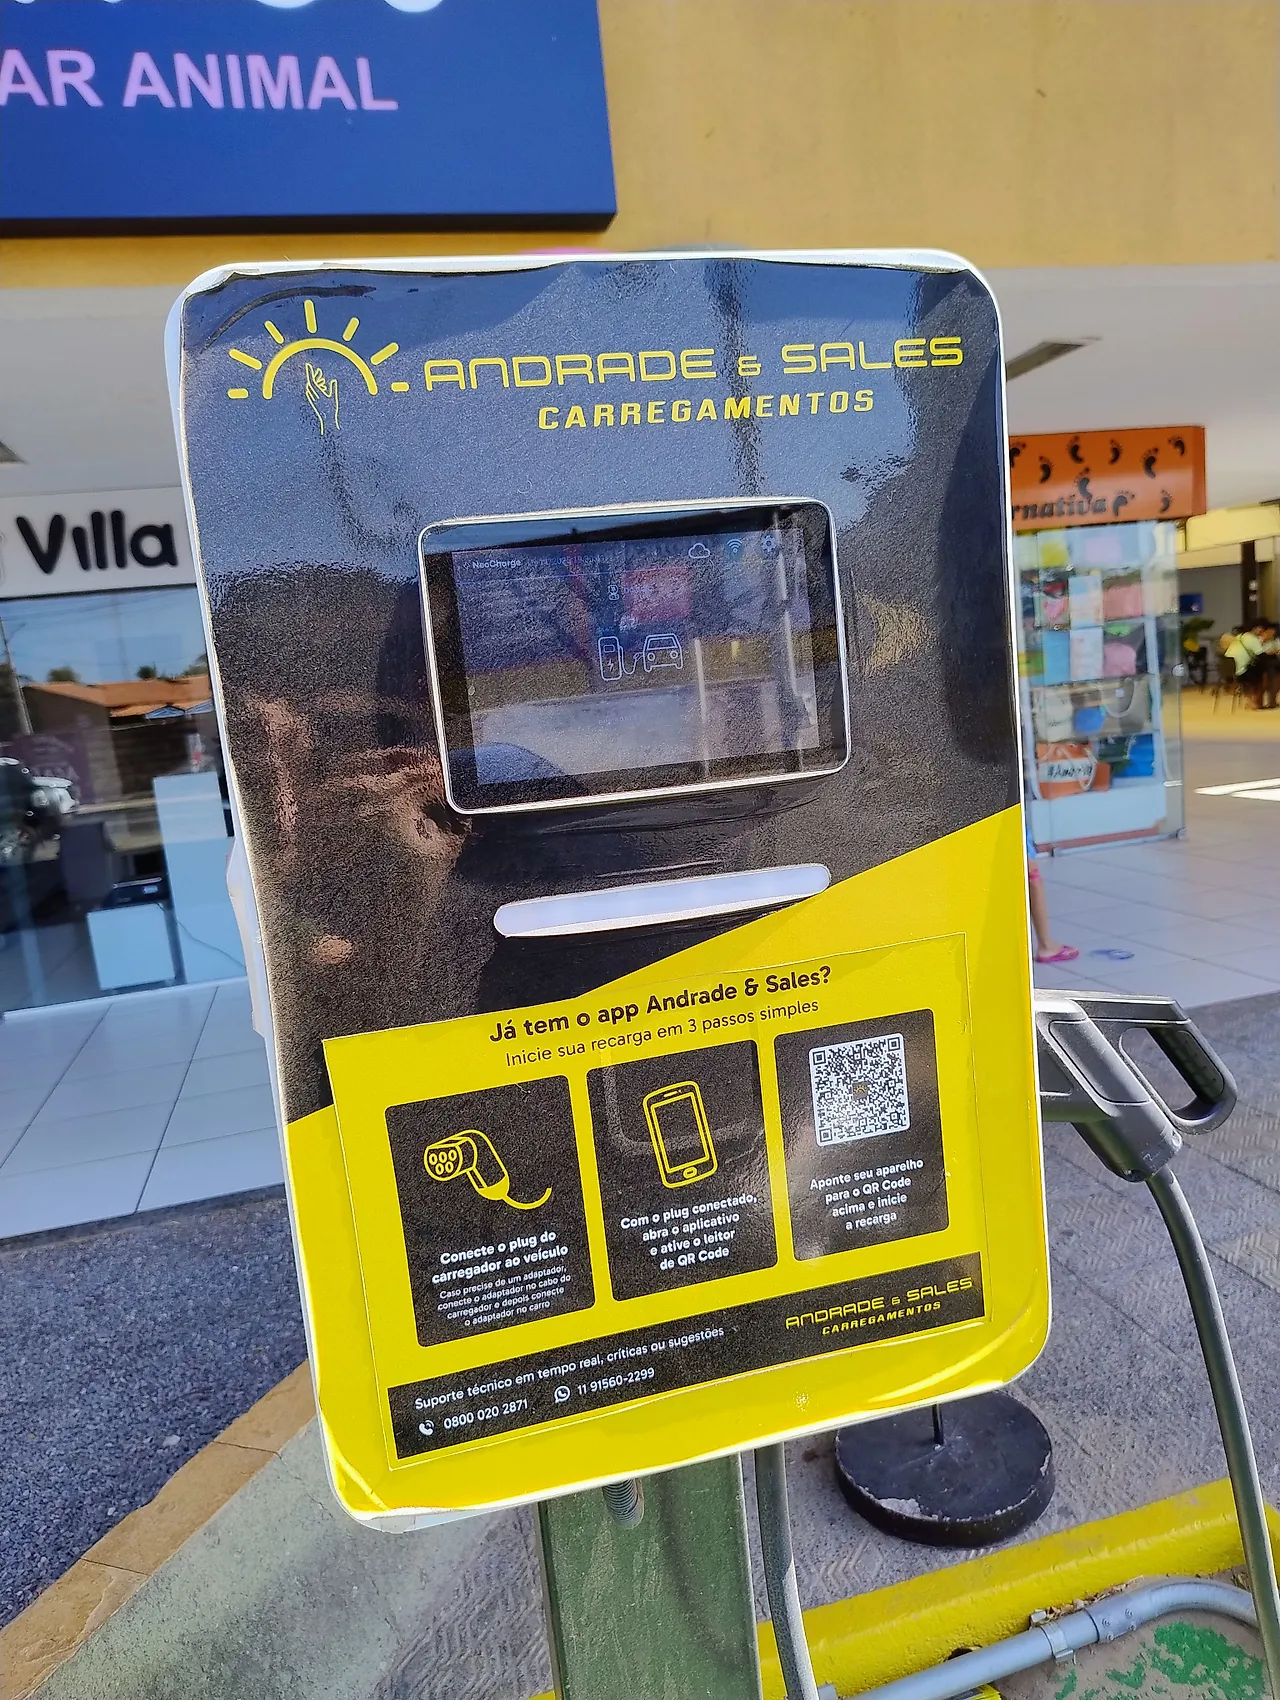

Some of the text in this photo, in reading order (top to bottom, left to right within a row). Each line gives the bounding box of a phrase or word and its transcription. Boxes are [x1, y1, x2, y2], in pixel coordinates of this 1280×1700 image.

[0, 49, 399, 110] AR ANIMAL
[424, 338, 964, 391] ANDRADE & SALES
[538, 390, 875, 430] CARREGAMENTOS
[472, 559, 521, 569] NeoCharge
[490, 966, 832, 1042] Já tem o app Andrade & Sales?
[506, 1000, 819, 1067] Inicie sua recarga em 3 passos simples
[810, 1159, 924, 1190] Aponte seu aparelho
[825, 1177, 911, 1205] para o QR Code
[621, 1194, 757, 1229] Com o plug conectado,
[832, 1193, 907, 1217] acima e inicie
[846, 1212, 897, 1230] a recarga
[642, 1213, 740, 1241] abra o aplicativo
[650, 1229, 735, 1256] e ative o leitor
[440, 1231, 556, 1264] Conecte o plug do
[660, 1247, 729, 1270] de QR Code
[432, 1246, 568, 1284] carregador ao veículo
[437, 1298, 472, 1310] conecte
[482, 1286, 524, 1301] adaptador
[539, 1279, 558, 1288] cabo
[560, 1274, 571, 1282] do
[440, 1290, 461, 1299] Caso
[508, 1276, 521, 1285] um
[447, 1303, 492, 1319] carregador
[502, 1295, 529, 1307] depois
[532, 1287, 564, 1300] conecte
[786, 1297, 884, 1329] ANDRADE
[907, 1277, 973, 1301] SALES
[473, 1309, 514, 1325] adaptador
[529, 1301, 550, 1312] carro
[822, 1302, 941, 1335] CARREGAMENTOS
[415, 1327, 724, 1410] Suporte técnico em tempo real, críticas ou sugestões
[443, 1367, 655, 1429] 0800 020 2871 11 91560-2299
